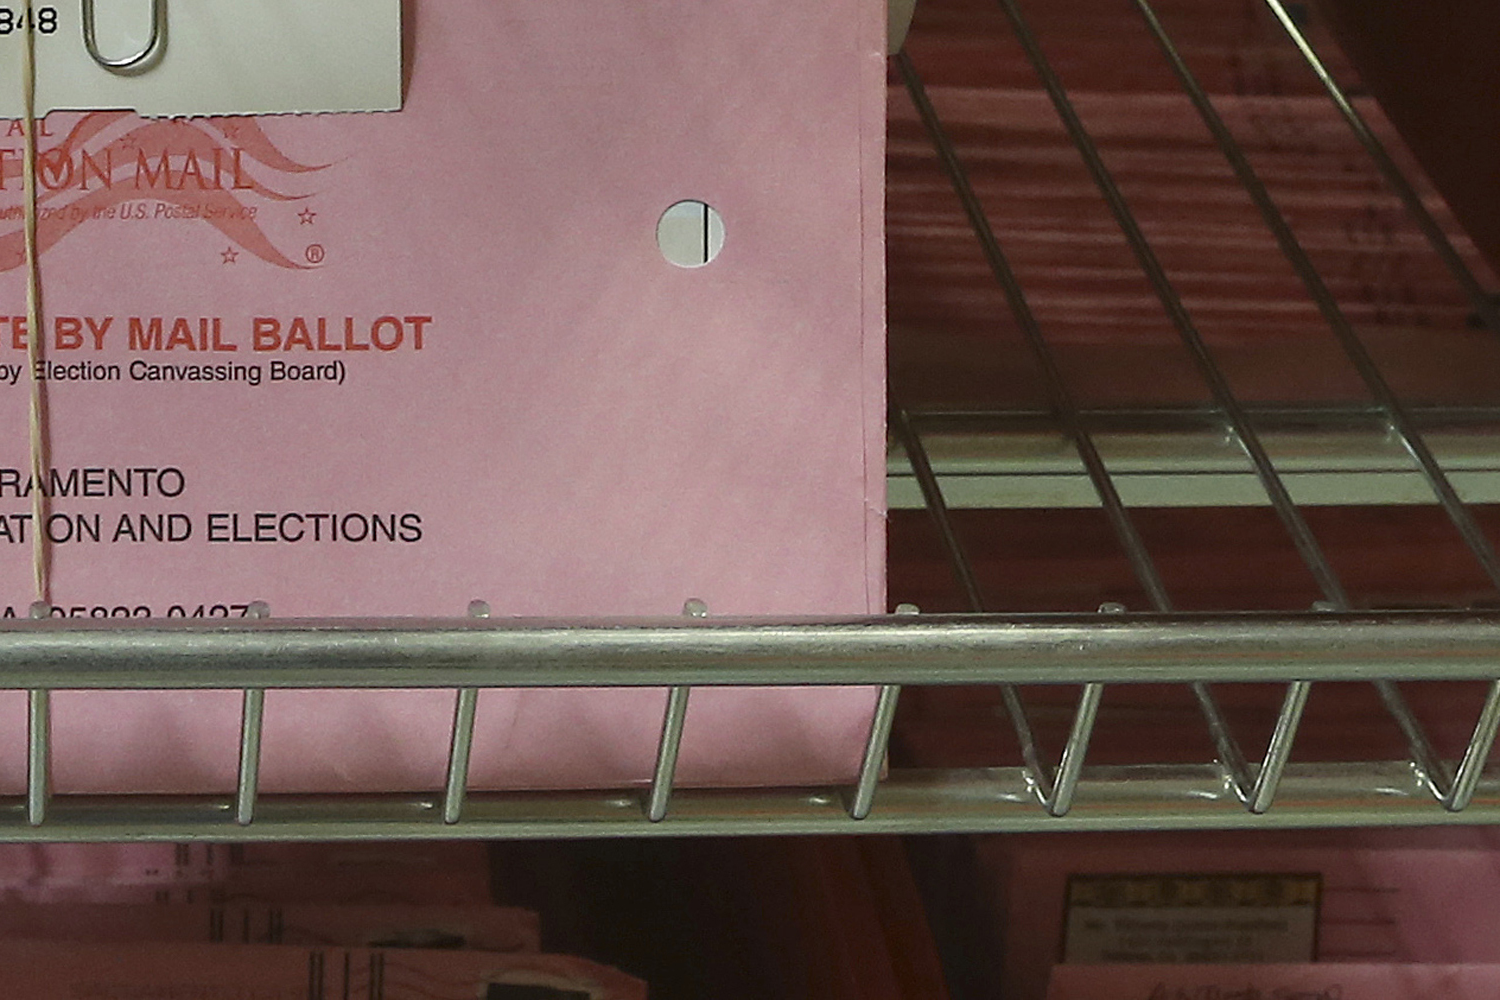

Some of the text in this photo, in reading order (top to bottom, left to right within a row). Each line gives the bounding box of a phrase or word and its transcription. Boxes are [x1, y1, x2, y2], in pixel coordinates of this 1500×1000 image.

[135, 146, 255, 190] MAIL
[119, 202, 149, 220] U.S.
[153, 202, 201, 220] Postal
[55, 316, 114, 351] BY
[128, 316, 238, 351] MAIL
[252, 315, 432, 351] BALLOT
[35, 360, 121, 381] Election
[129, 360, 261, 386] Canvassing
[270, 360, 346, 385] Board)
[112, 513, 192, 544] AND
[207, 513, 423, 544] ELECTIONS
